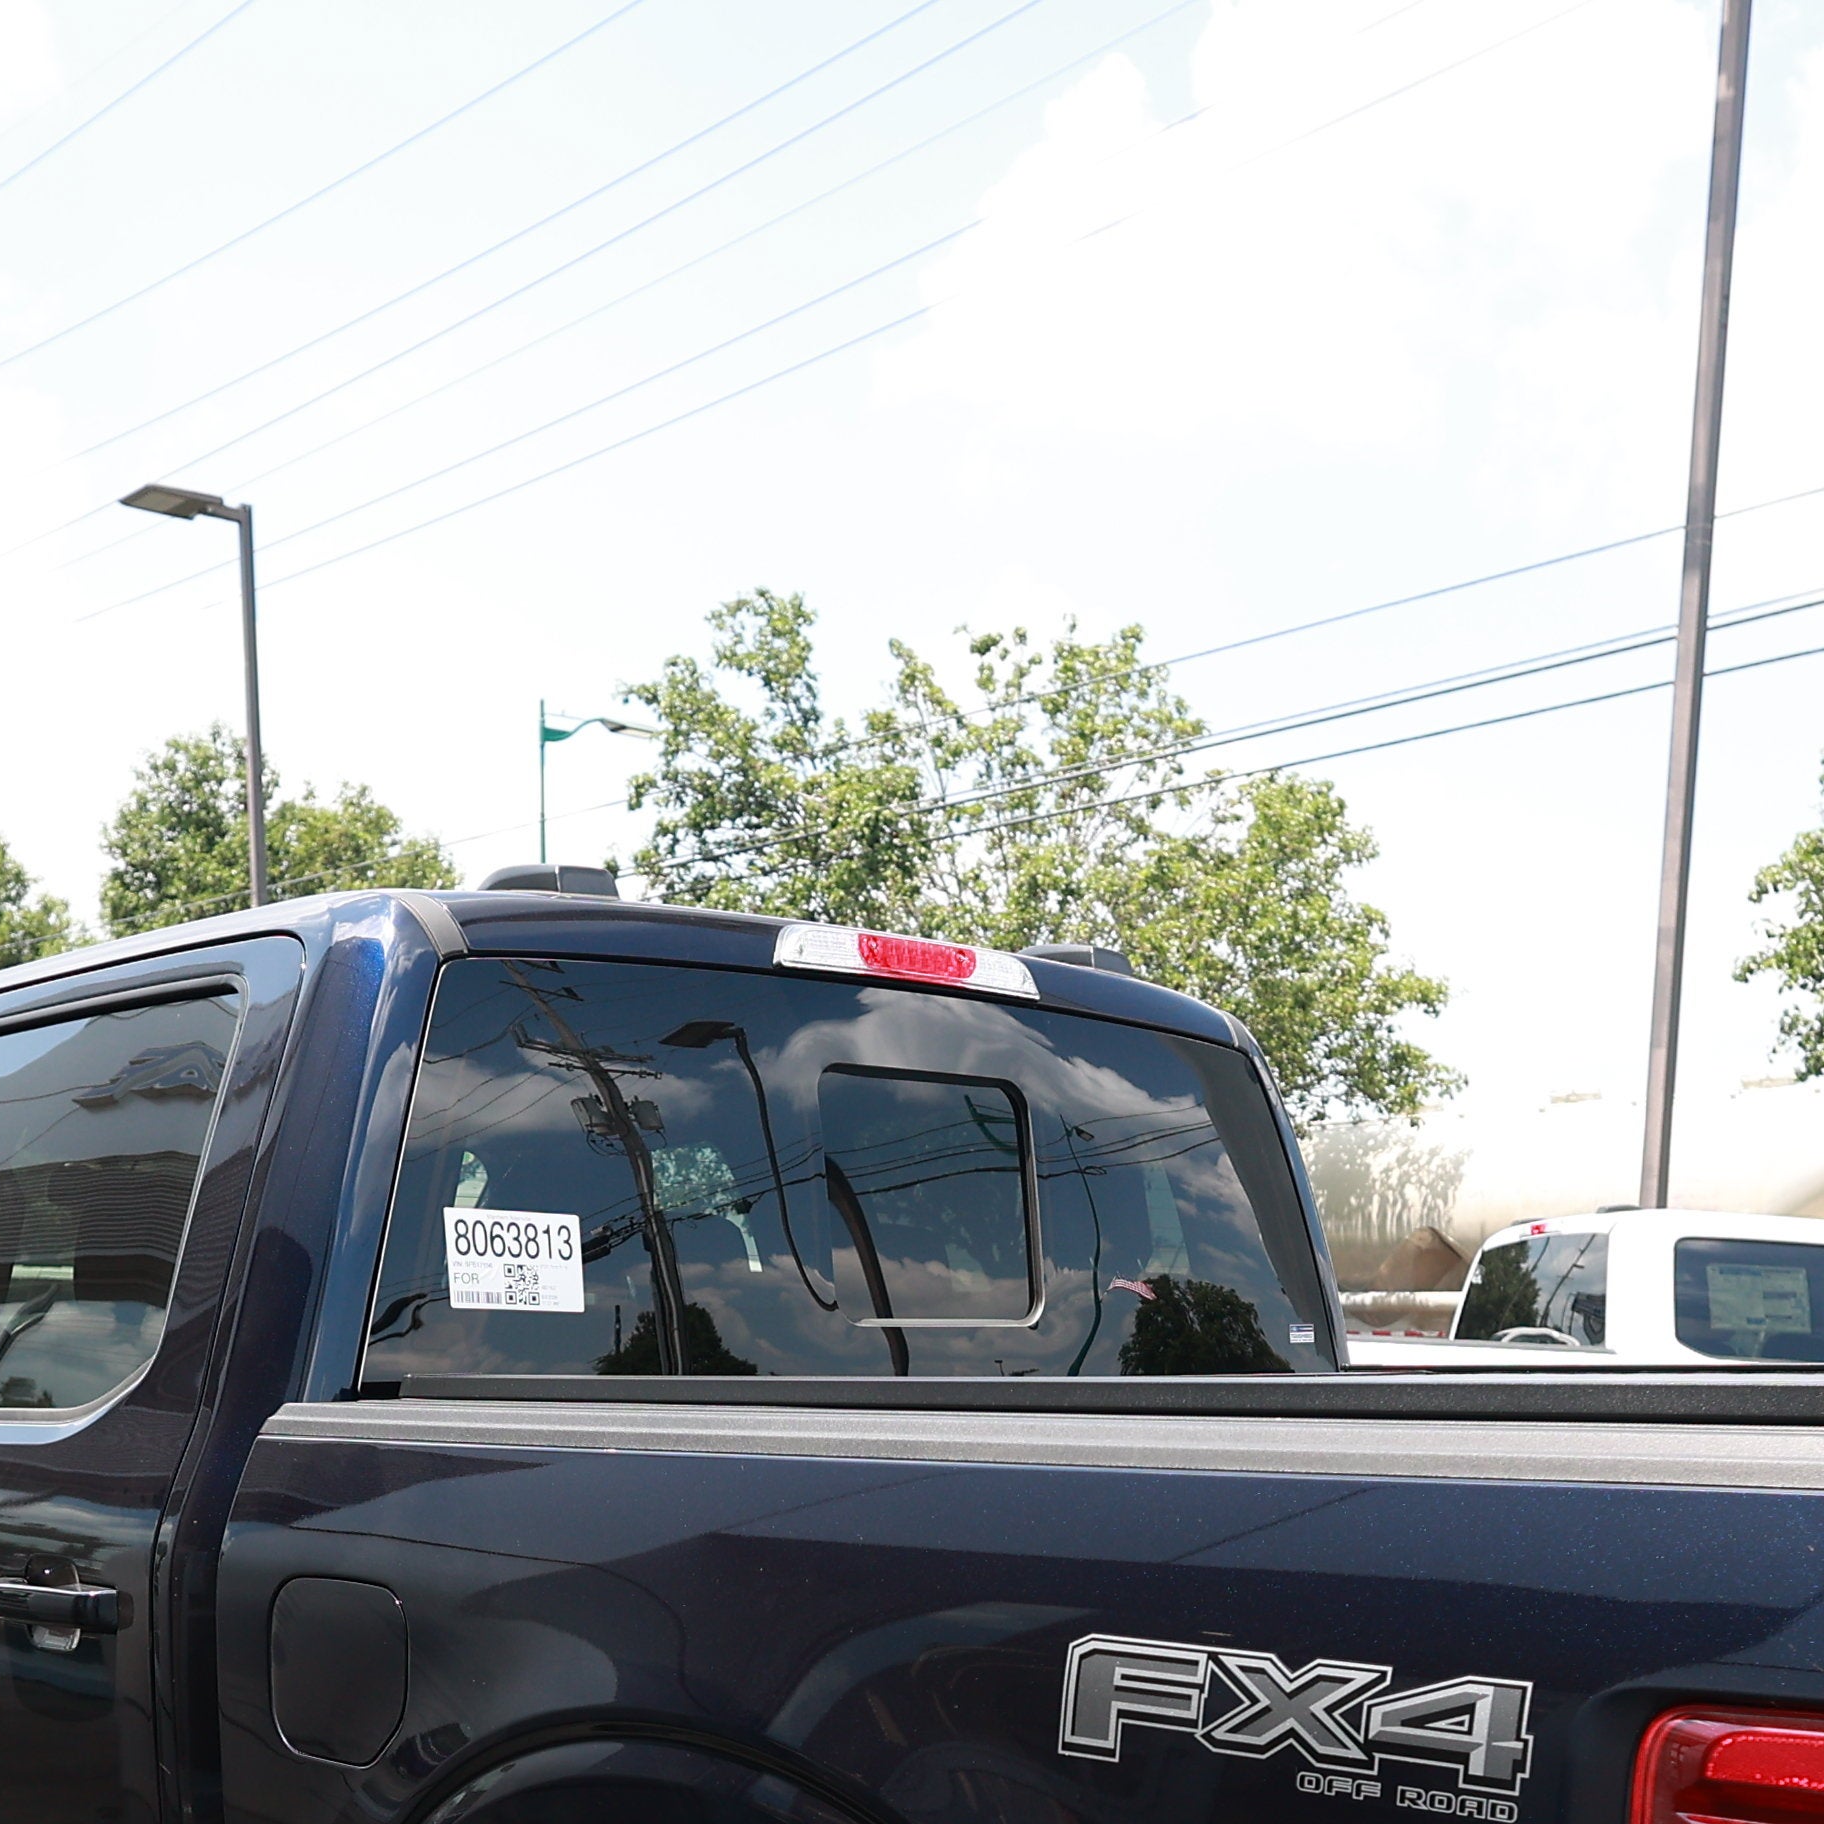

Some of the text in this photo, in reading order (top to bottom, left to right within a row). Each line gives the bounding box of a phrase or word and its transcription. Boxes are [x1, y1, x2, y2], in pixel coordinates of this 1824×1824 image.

[454, 1218, 573, 1261] 8063813
[453, 1272, 480, 1284] FOR
[1058, 1632, 1535, 1796] FX4
[1295, 1770, 1518, 1824] OFF ROAD
